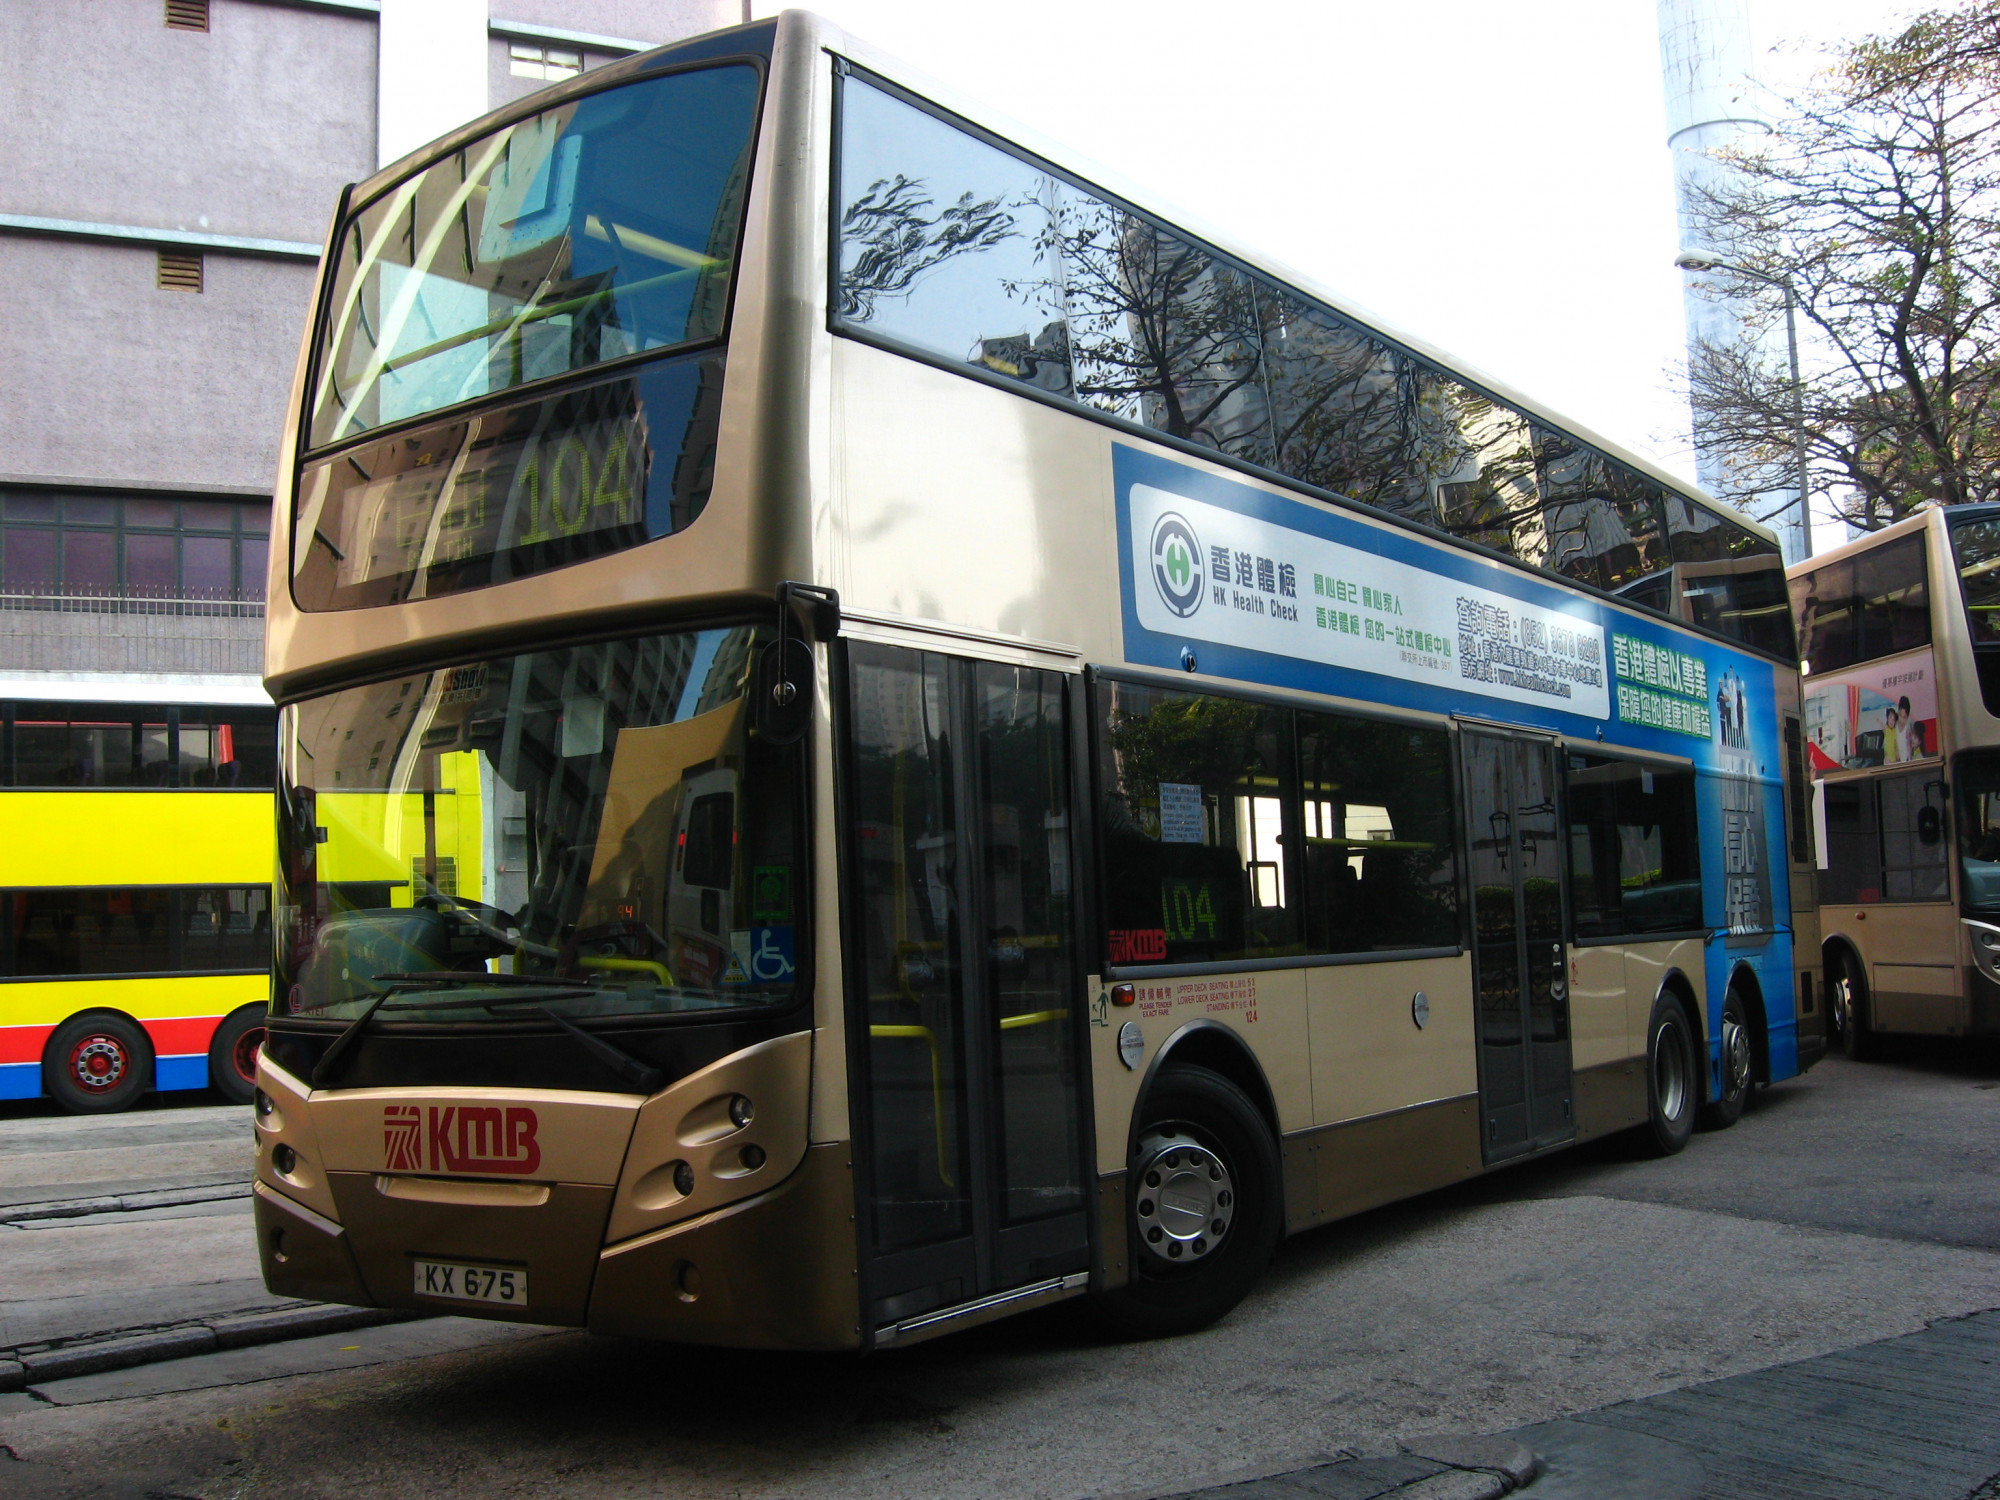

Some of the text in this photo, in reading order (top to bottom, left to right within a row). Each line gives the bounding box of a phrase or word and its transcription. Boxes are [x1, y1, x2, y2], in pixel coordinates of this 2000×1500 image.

[517, 429, 634, 546] 104
[1210, 545, 1297, 599] 香港體檢
[1213, 586, 1299, 622] HK Health Check
[1316, 606, 1452, 657] 香港體檢 您的一站式體檢中心
[1612, 633, 1707, 700] 香港體檢以專業
[1618, 684, 1712, 739] 保障您的健康和權益
[1161, 883, 1217, 941] 104
[1125, 929, 1166, 960] KMB
[1176, 985, 1194, 994] UPPER
[1195, 984, 1208, 992] DECK
[1209, 982, 1228, 991] SEATING
[1247, 977, 1256, 986] 53
[1177, 996, 1196, 1005] LOWER
[1196, 994, 1209, 1003] DECK
[1210, 992, 1229, 1002] SEATING
[1138, 1001, 1172, 1010] PLEASE TENDER
[1142, 1010, 1157, 1018] EXACT
[1206, 1002, 1230, 1012] STANDING
[1248, 998, 1257, 1008] 44
[1245, 1011, 1258, 1023] 124
[429, 1106, 541, 1175] KMB
[425, 1264, 515, 1301] KX 675
